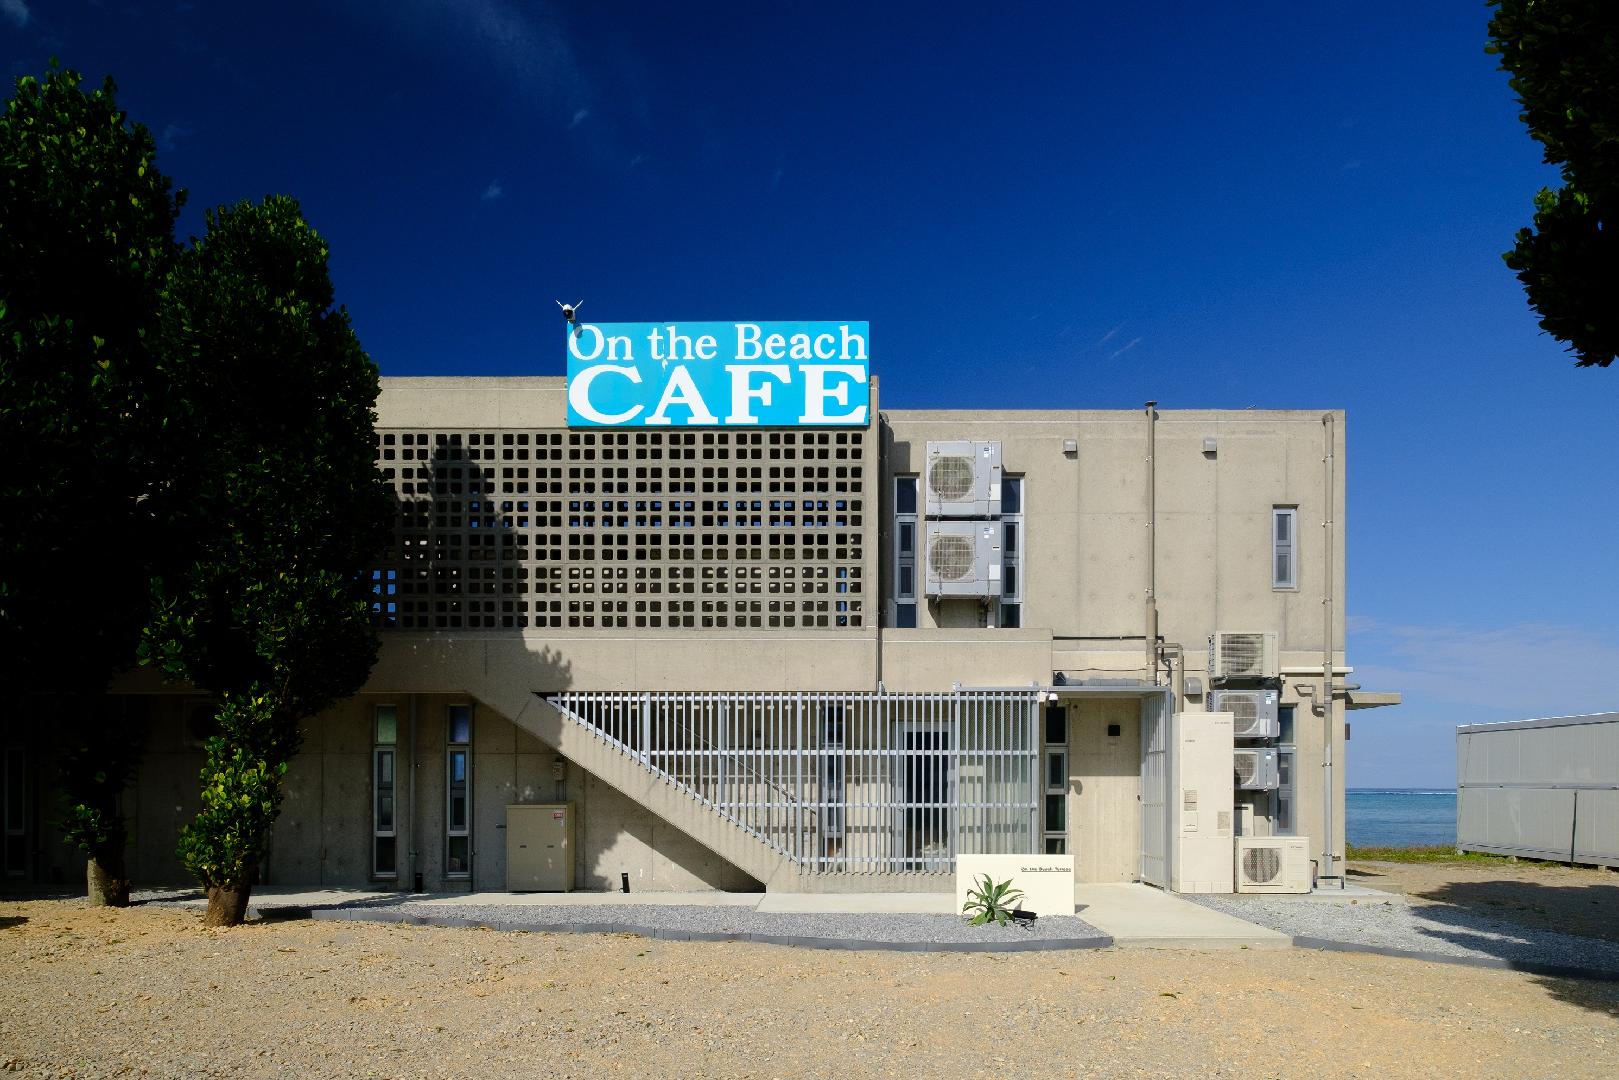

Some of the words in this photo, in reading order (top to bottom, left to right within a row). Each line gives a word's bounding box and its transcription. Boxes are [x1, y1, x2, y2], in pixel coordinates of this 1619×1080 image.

[569, 324, 633, 360] On
[648, 326, 717, 360] the
[735, 324, 867, 360] Beach
[569, 364, 867, 424] CAFE
